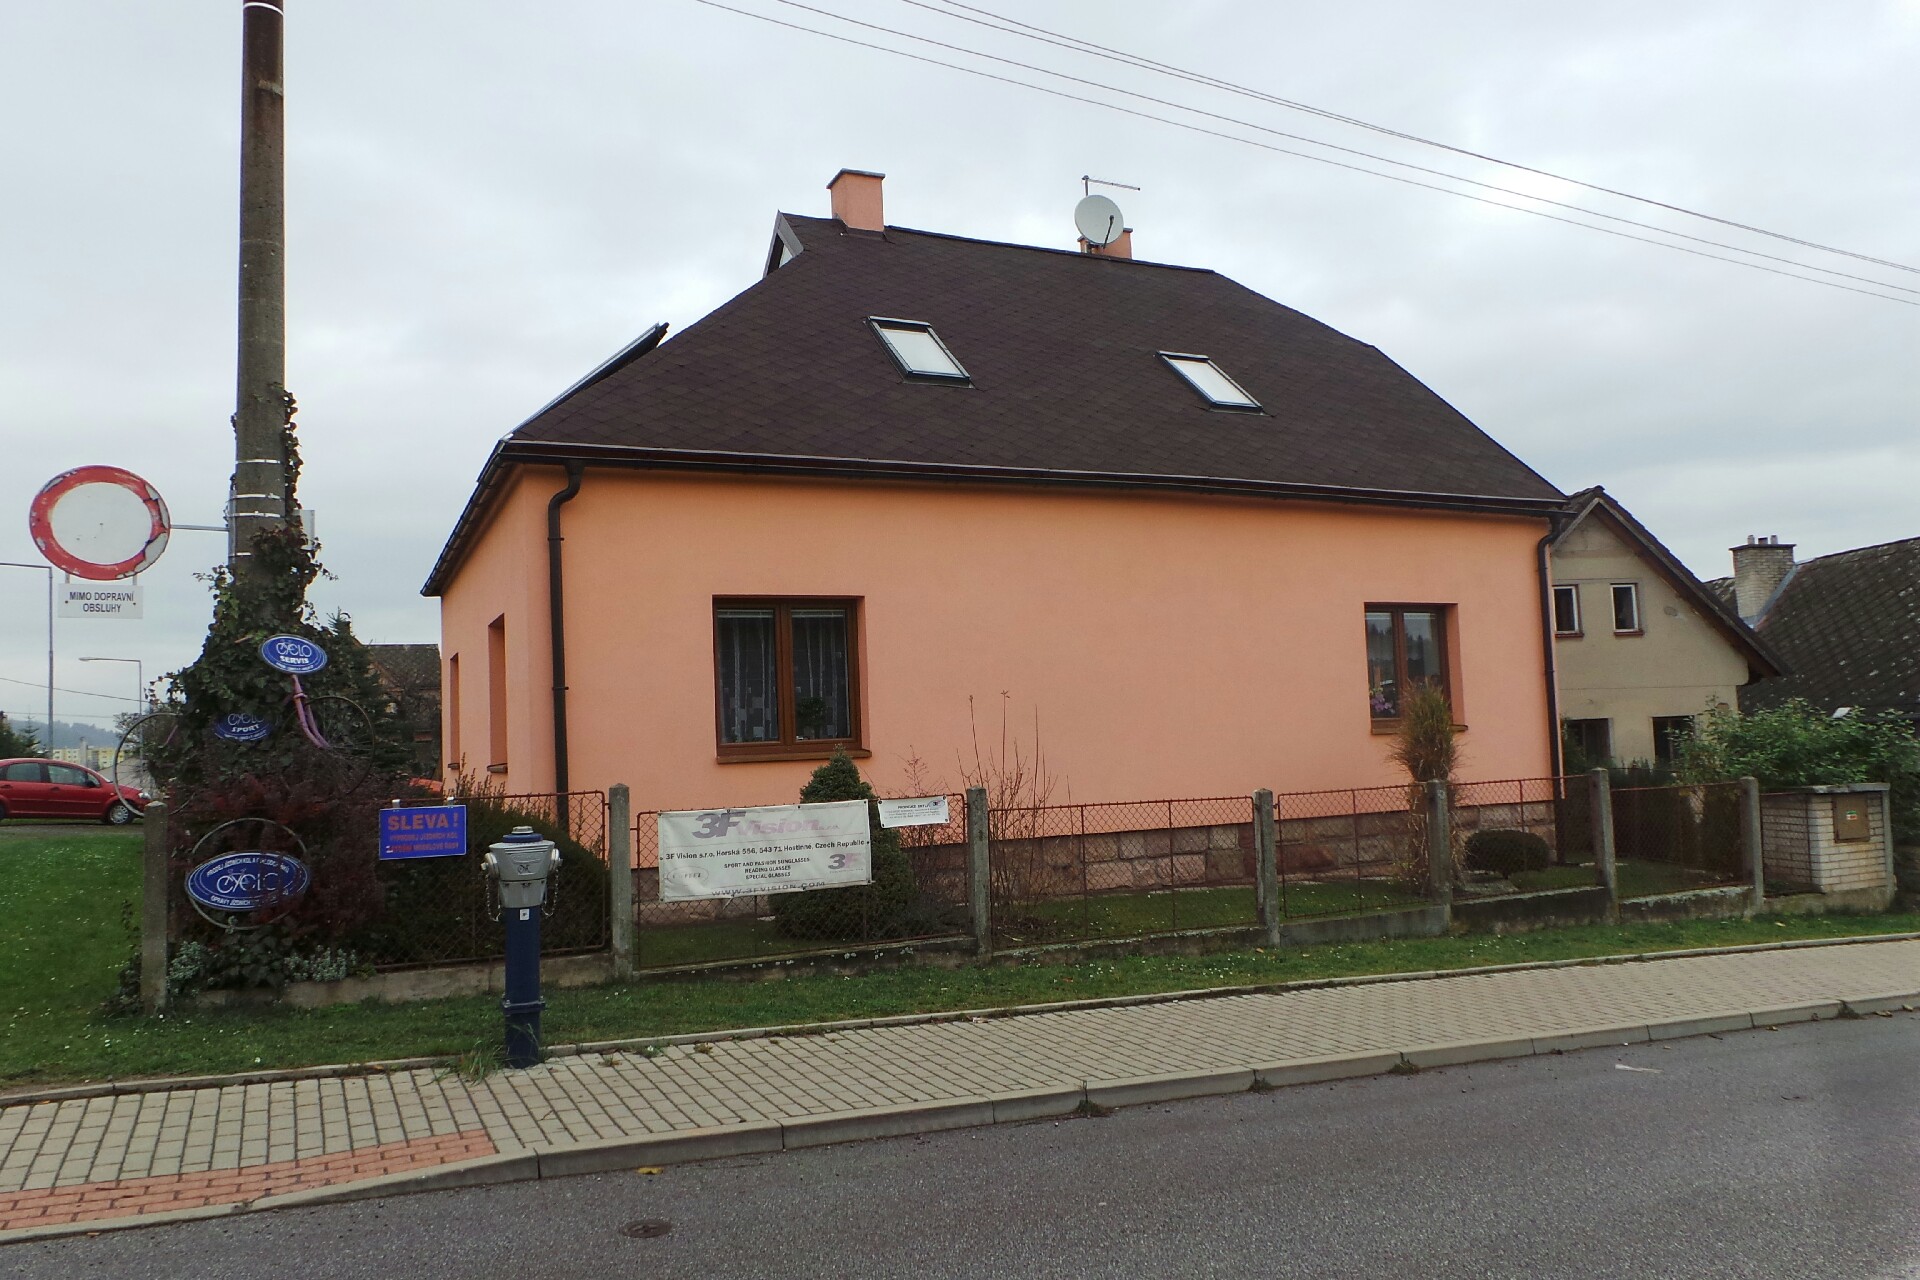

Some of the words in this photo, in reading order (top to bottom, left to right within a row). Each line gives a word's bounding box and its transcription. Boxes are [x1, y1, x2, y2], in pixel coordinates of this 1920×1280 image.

[69, 592, 92, 600] MIMO
[94, 591, 134, 602] DOPRAVNÍ
[83, 603, 121, 613] OBSLUHY
[280, 655, 309, 664] SERVIS
[231, 724, 259, 732] SPORT
[388, 813, 449, 830] SLEVA
[778, 857, 810, 865] SUNGLASSES
